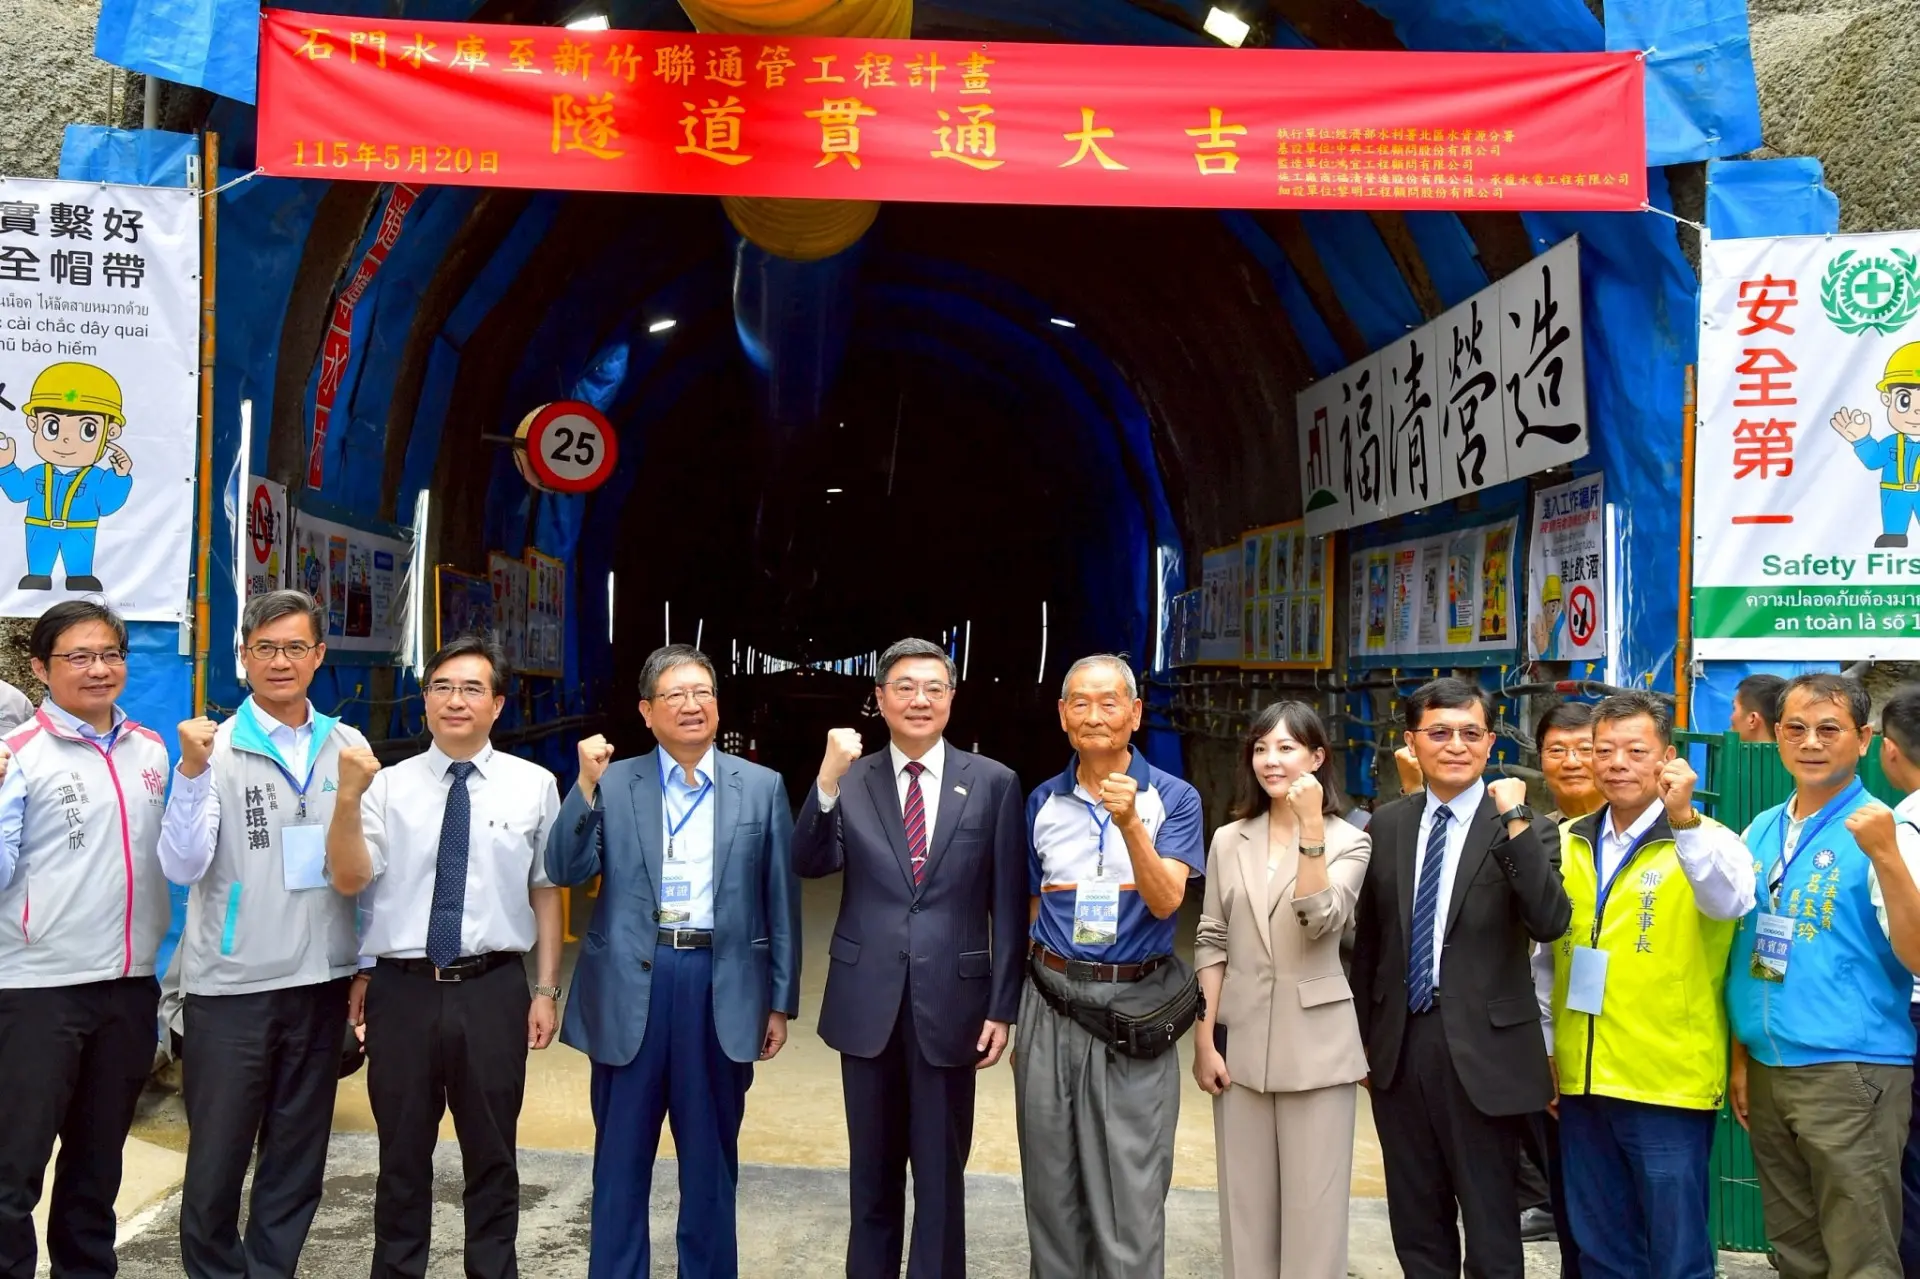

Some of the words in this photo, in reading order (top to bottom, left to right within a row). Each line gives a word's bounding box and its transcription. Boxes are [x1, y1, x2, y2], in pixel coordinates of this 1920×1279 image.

[292, 27, 997, 95] 石門水庫至新竹聯通管工程計畫
[291, 140, 500, 175] 115年5月20日
[549, 94, 1249, 178] 隧道貫通大吉
[0, 200, 144, 244] 實繫好
[0, 246, 145, 289] 全帽帶
[80, 320, 110, 338] dây
[114, 323, 149, 339] quai
[1340, 264, 1582, 515] 福清營造
[1731, 273, 1798, 525] 安全第一
[550, 427, 596, 466] 25
[1762, 554, 1856, 581] Safety
[1774, 617, 1799, 631] an
[1805, 613, 1852, 631] toàn
[1858, 613, 1876, 631] là
[1633, 891, 1657, 954] 董事長
